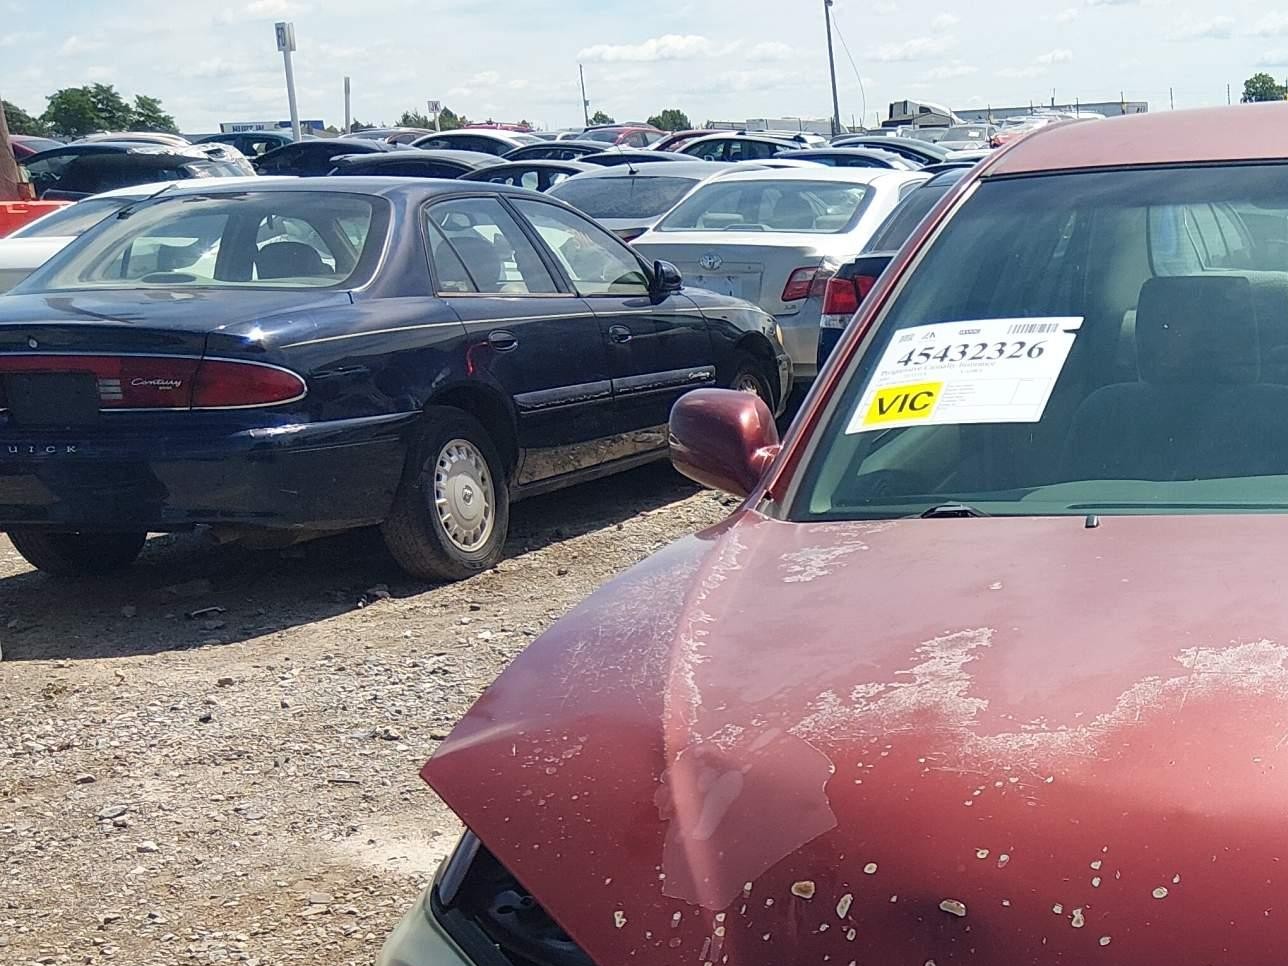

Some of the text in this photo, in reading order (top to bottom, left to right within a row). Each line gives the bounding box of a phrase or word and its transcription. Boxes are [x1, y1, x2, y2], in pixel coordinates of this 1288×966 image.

[897, 340, 1049, 367] 45432326
[131, 377, 182, 388] Century
[877, 391, 934, 416] VIC
